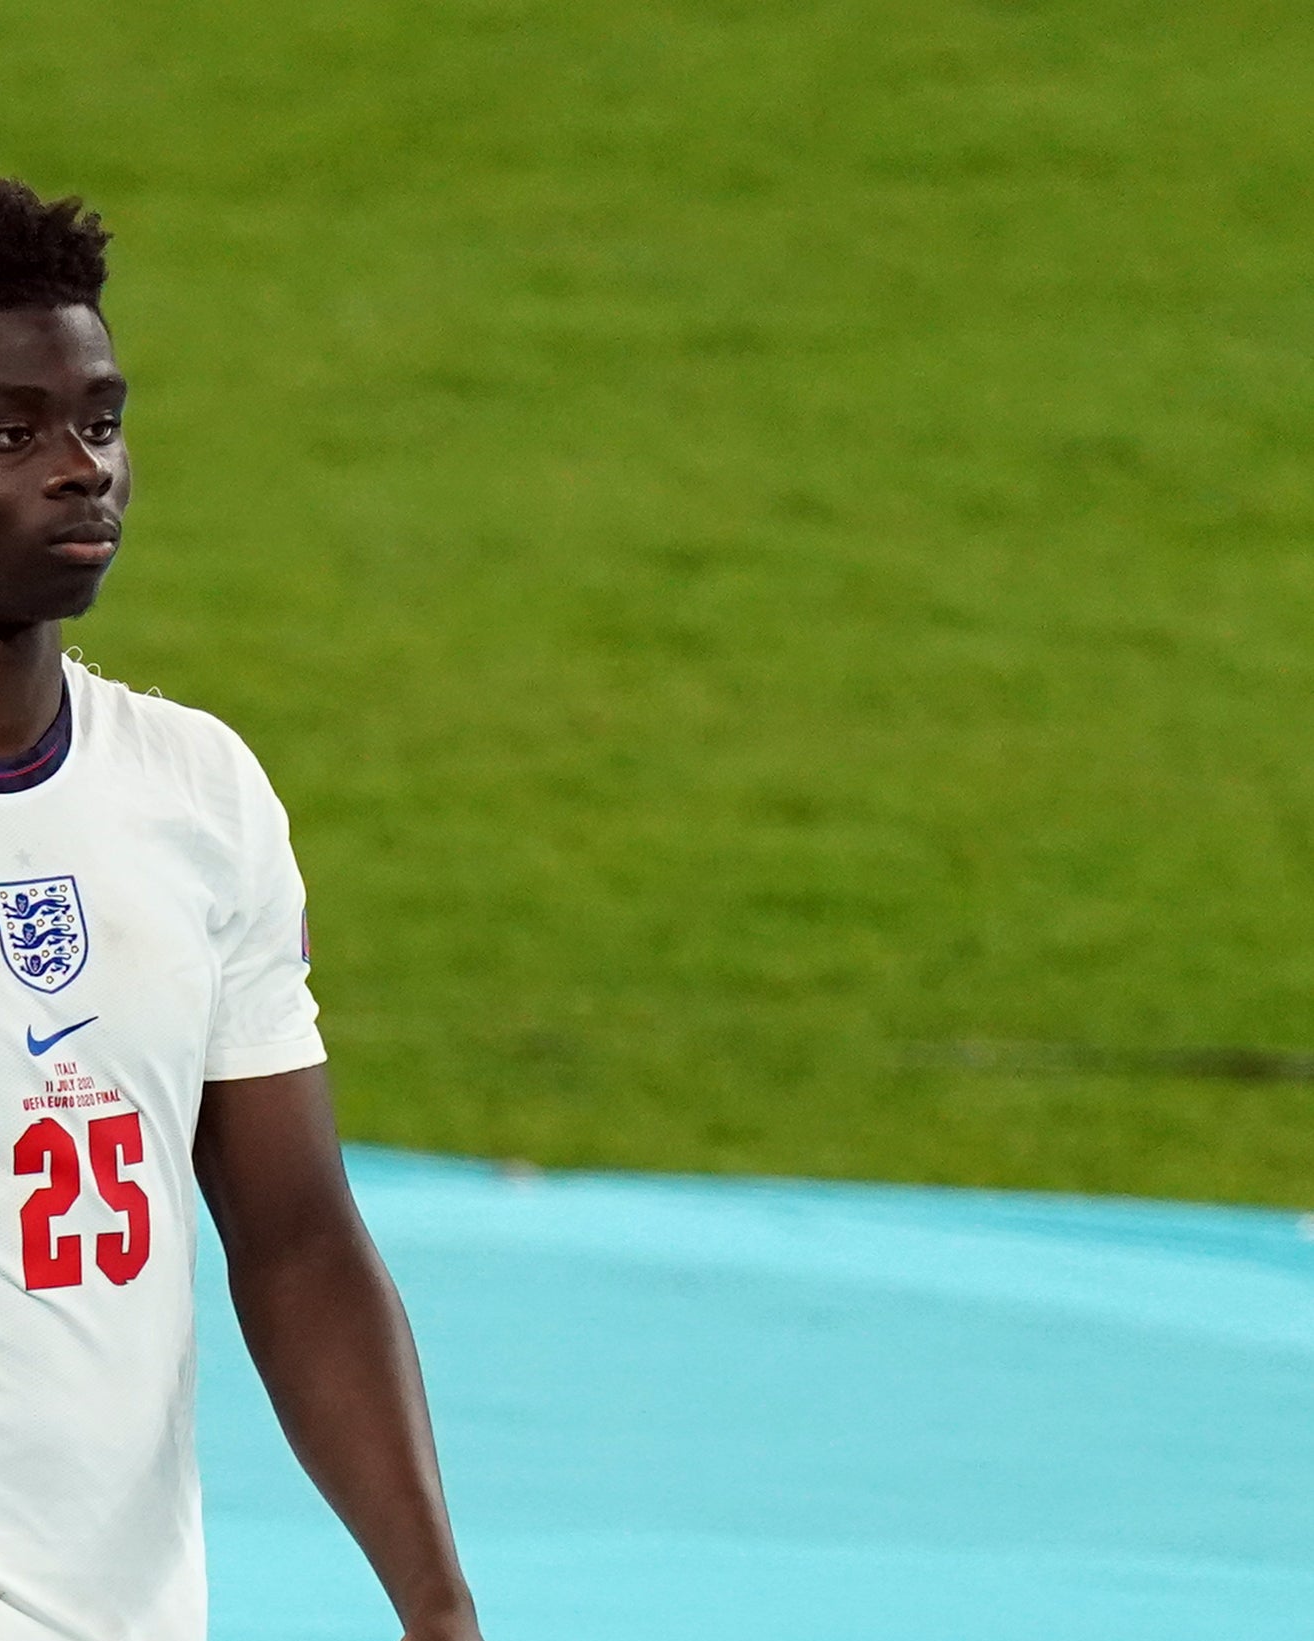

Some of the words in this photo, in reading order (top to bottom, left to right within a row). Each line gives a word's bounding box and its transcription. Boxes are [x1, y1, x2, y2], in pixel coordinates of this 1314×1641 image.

[54, 1062, 78, 1076] ITALY
[45, 1081, 54, 1093] 11
[57, 1079, 76, 1092] JULY
[77, 1077, 95, 1090] 2021
[23, 1096, 45, 1111] UEFA
[47, 1095, 75, 1109] EURO
[76, 1094, 96, 1108] 2020
[95, 1089, 121, 1105] FINAL
[14, 1112, 150, 1290] 25
